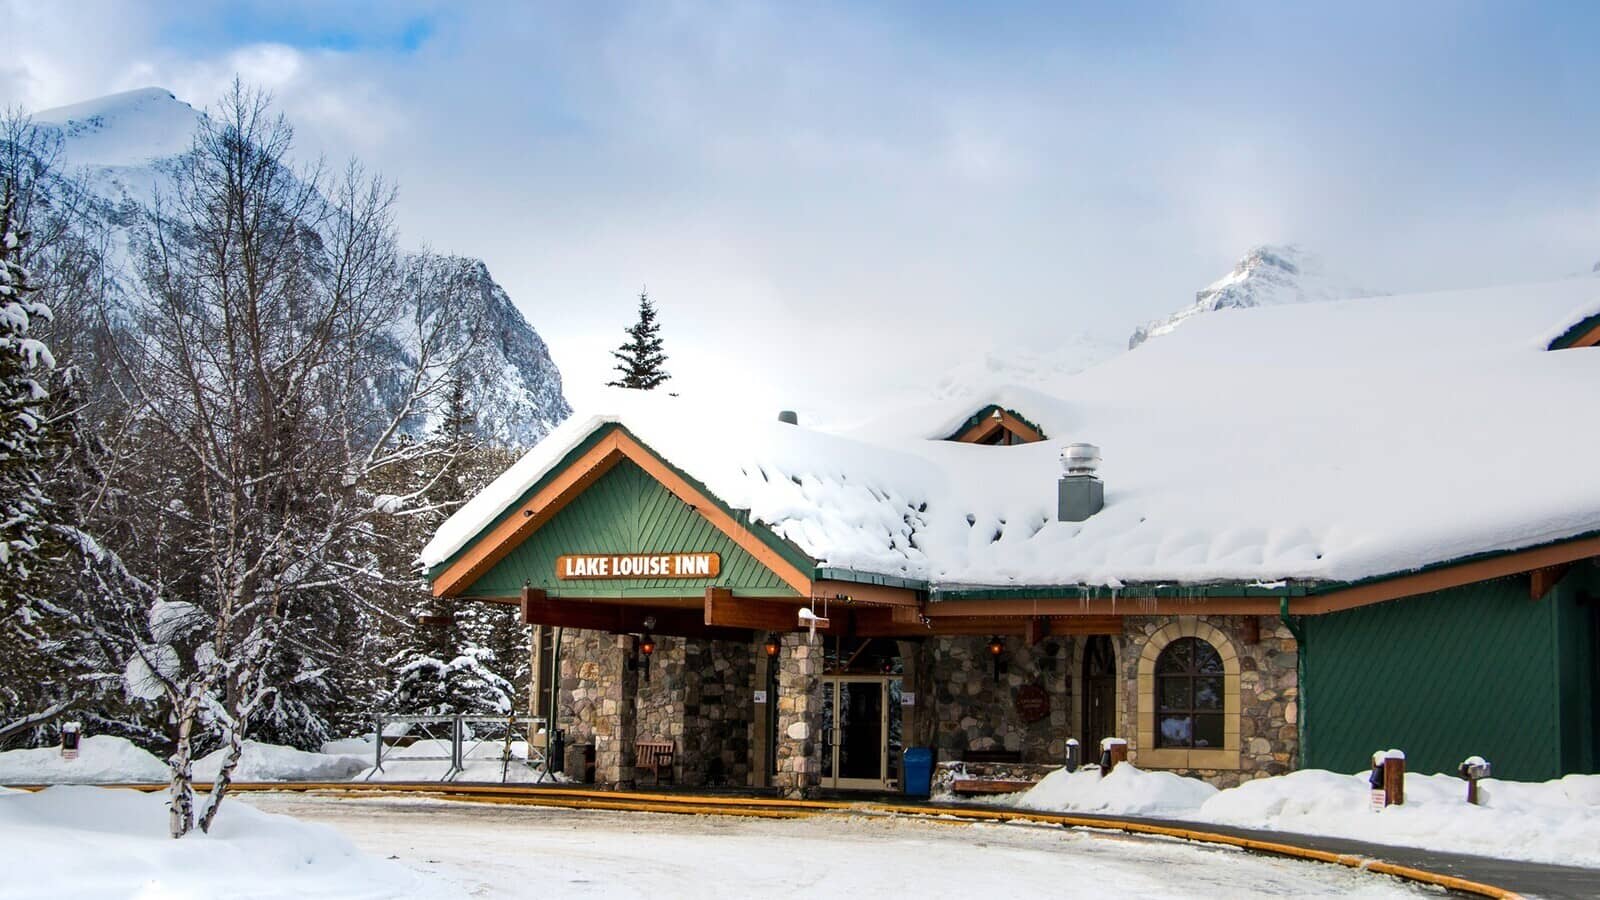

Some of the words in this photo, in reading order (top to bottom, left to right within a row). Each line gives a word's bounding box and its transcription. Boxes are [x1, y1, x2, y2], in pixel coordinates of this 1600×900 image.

[566, 557, 608, 576] LAKE
[612, 556, 670, 576] LOUISE
[675, 555, 709, 575] INN
